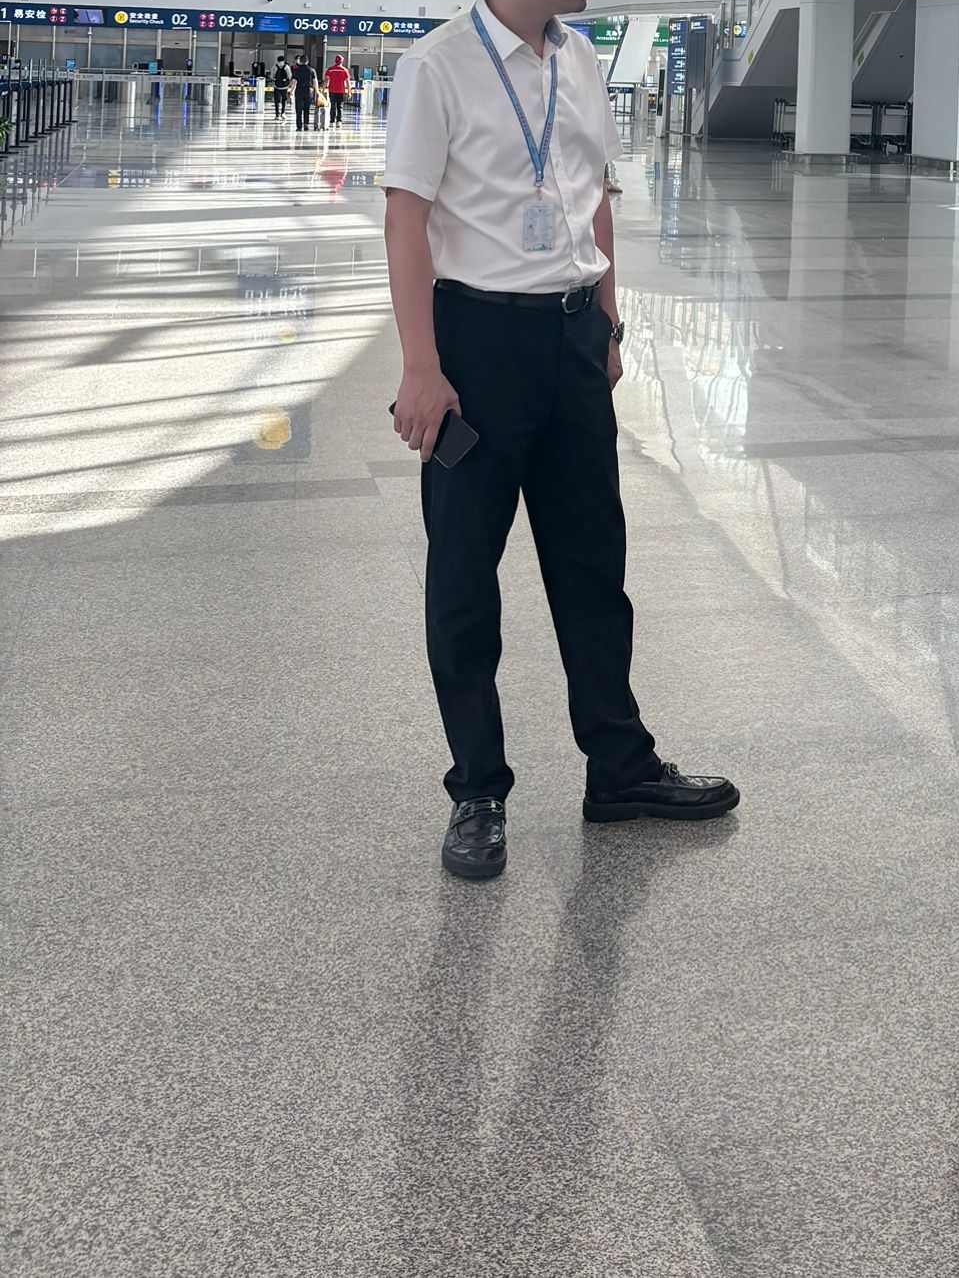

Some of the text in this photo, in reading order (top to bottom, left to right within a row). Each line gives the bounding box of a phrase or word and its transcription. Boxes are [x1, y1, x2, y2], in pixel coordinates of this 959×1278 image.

[14, 8, 47, 19] 易安检
[171, 13, 188, 25] 02
[219, 15, 254, 28] 03-04
[293, 18, 329, 31] 05-06
[358, 20, 374, 32] 07
